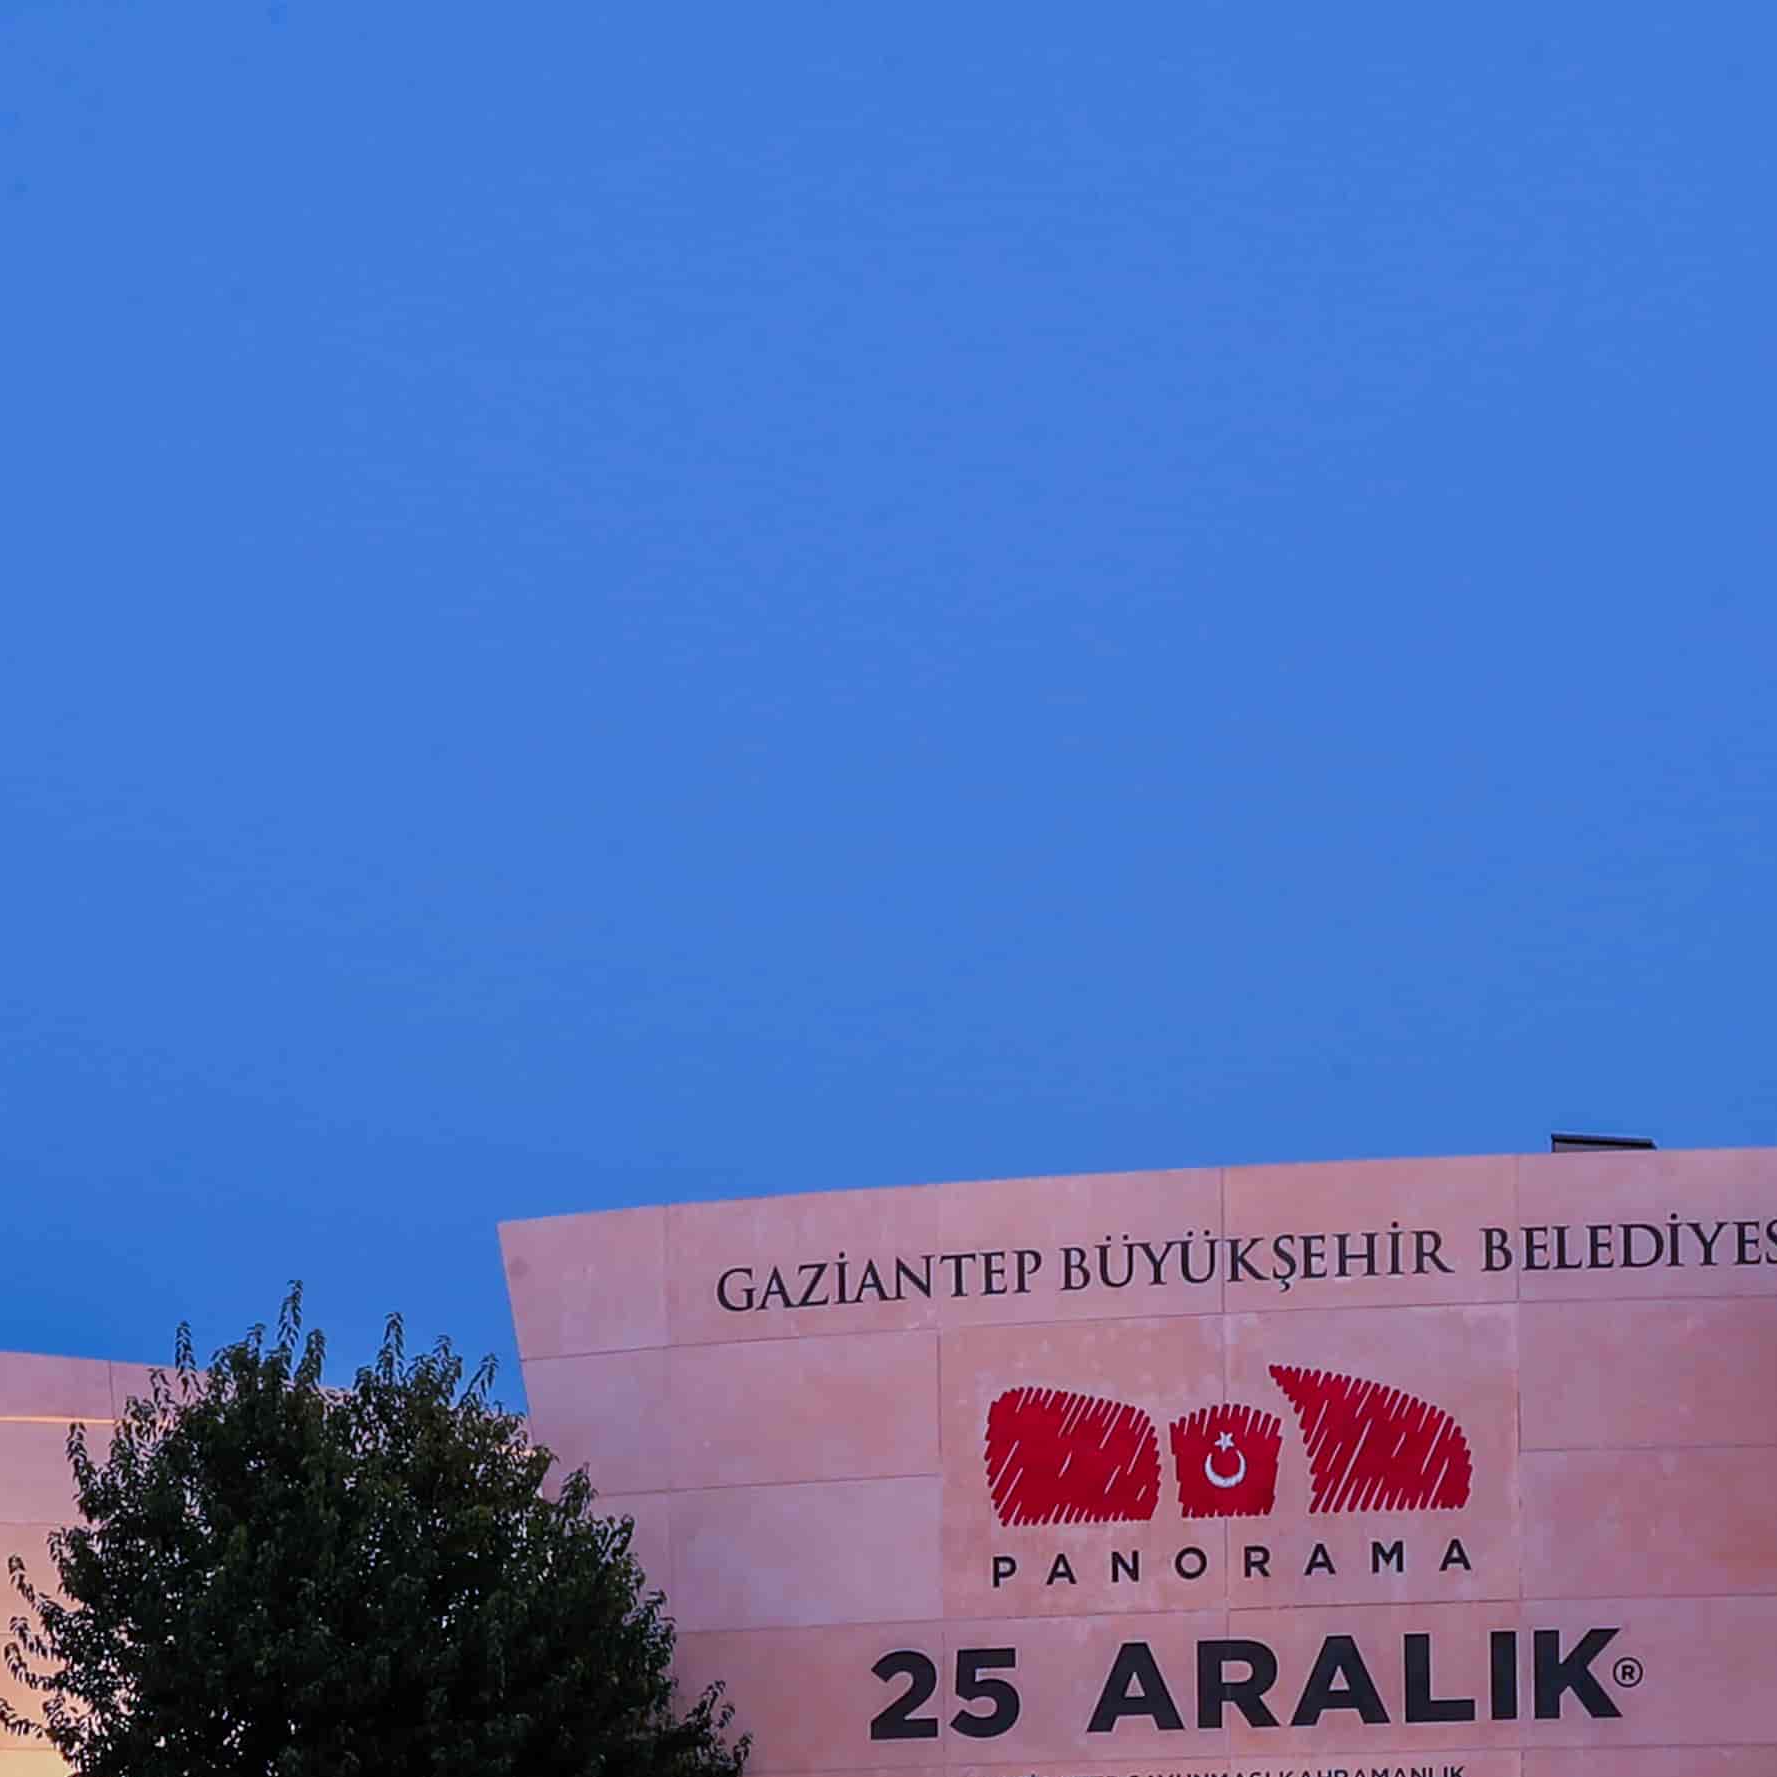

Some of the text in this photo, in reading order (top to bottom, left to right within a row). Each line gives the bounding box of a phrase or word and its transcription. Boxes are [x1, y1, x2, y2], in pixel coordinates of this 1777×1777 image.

[716, 1249, 1042, 1312] GAZİANTEP
[1059, 1222, 1455, 1293] BÜYÜKŞEHİR
[992, 1538, 1472, 1588] PANORAMA
[870, 1648, 1021, 1740] 25
